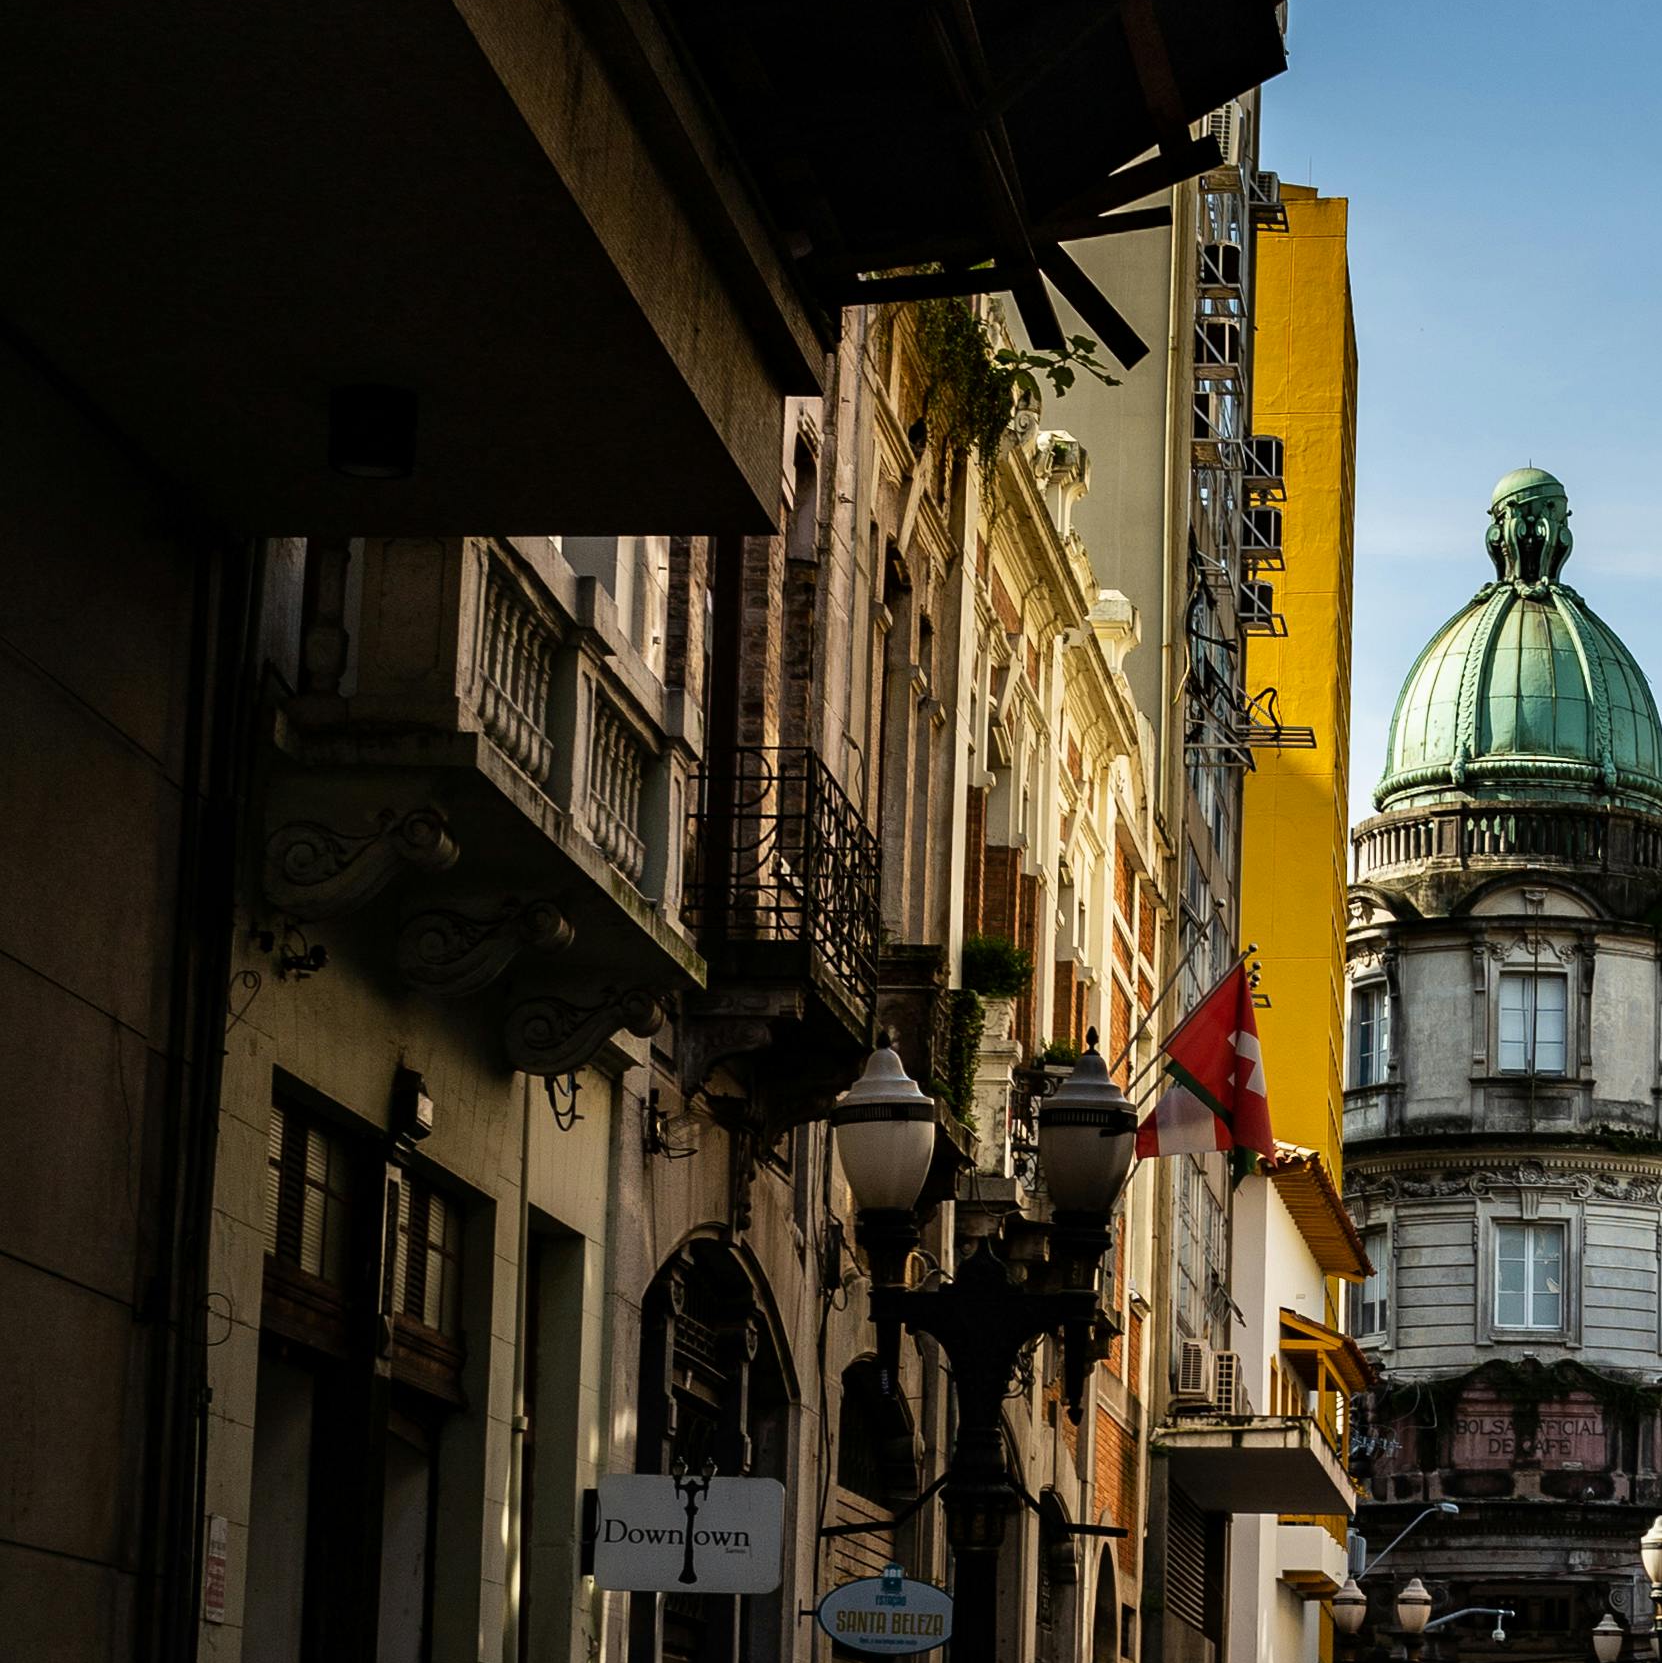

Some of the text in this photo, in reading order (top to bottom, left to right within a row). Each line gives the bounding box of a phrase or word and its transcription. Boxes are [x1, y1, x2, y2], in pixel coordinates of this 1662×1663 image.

[1456, 1419, 1516, 1436] BOLSA
[1489, 1439, 1514, 1454] DE
[836, 1610, 945, 1637] SANTA BELEZA
